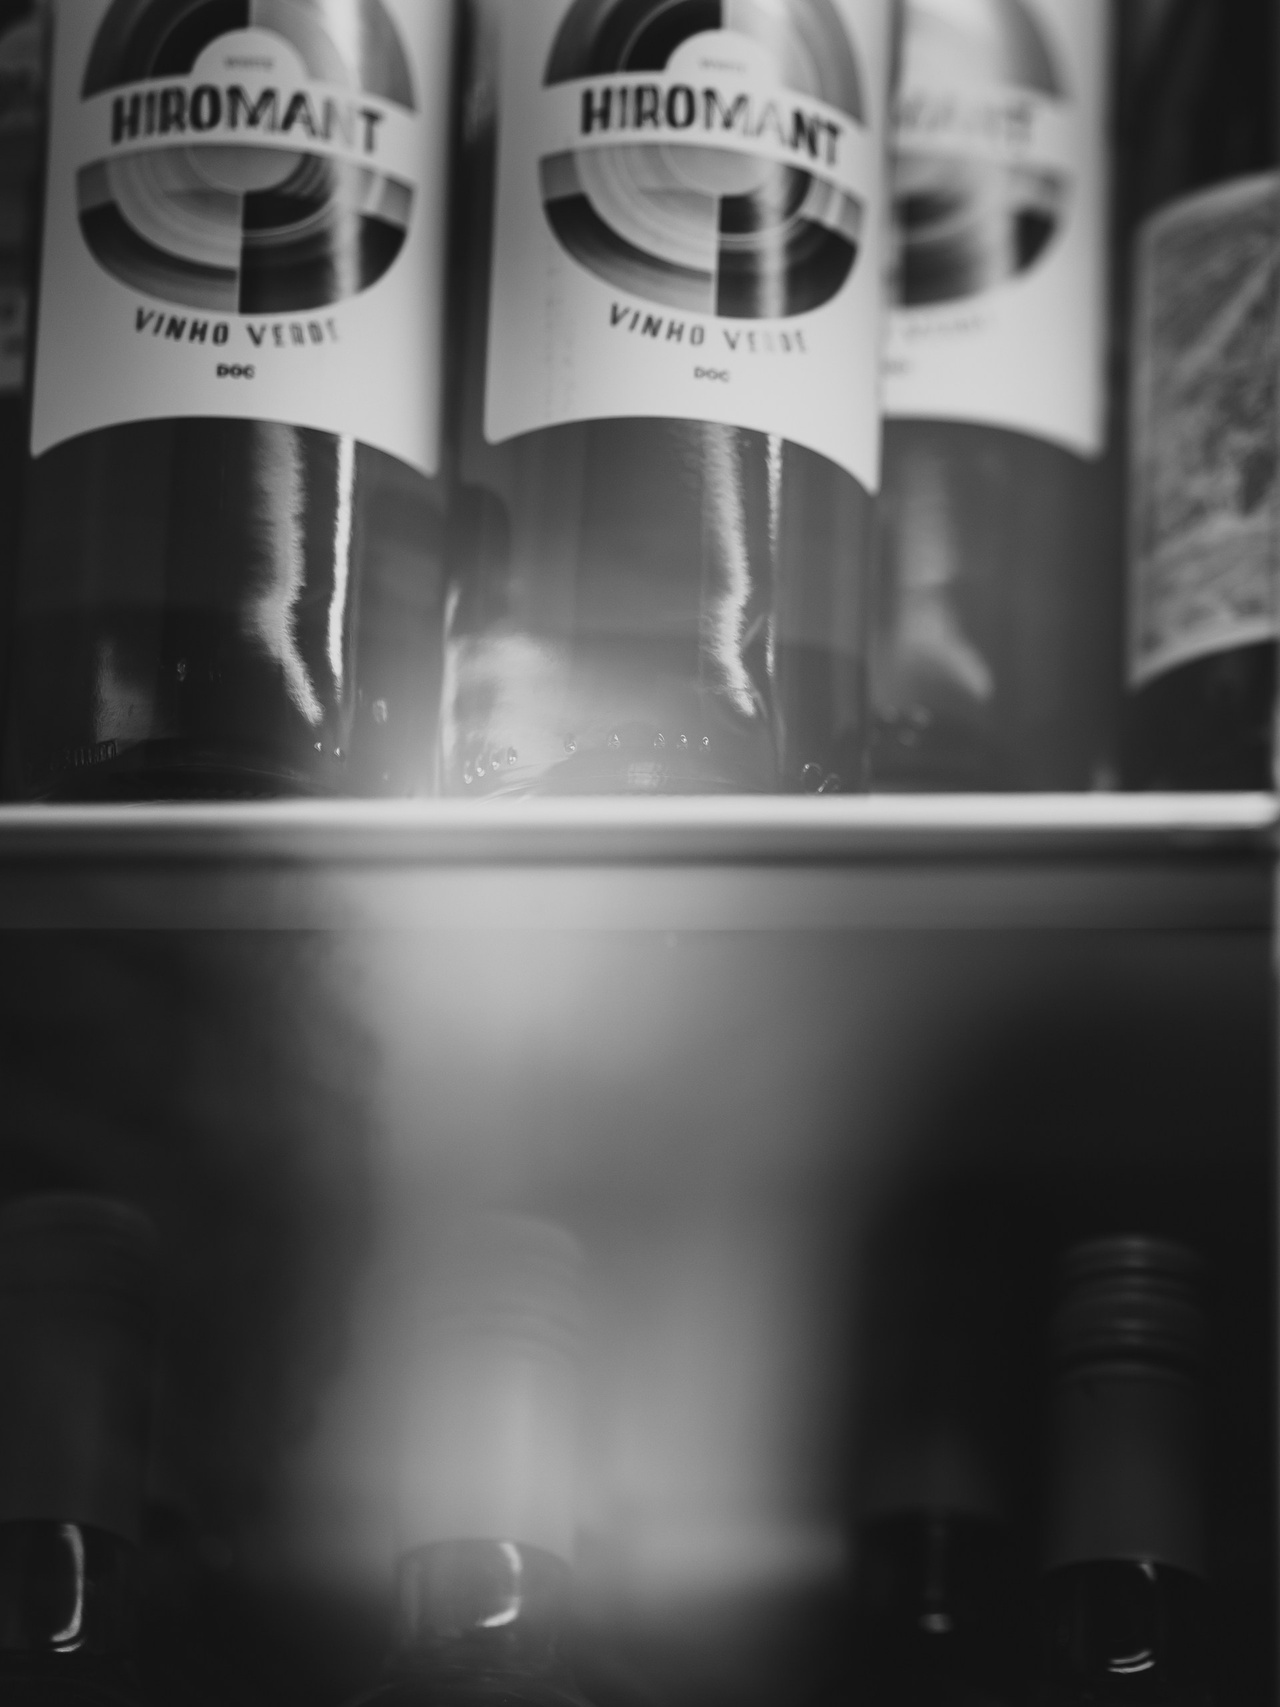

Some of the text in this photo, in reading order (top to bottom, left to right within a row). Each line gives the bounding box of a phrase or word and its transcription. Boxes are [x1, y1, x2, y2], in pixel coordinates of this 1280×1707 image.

[111, 84, 383, 152] HIROMANT
[580, 84, 840, 166] HIROMANT
[135, 306, 230, 345] VINHO
[609, 302, 706, 346] VINHO
[216, 362, 256, 379] DOC
[693, 366, 730, 383] DOC
